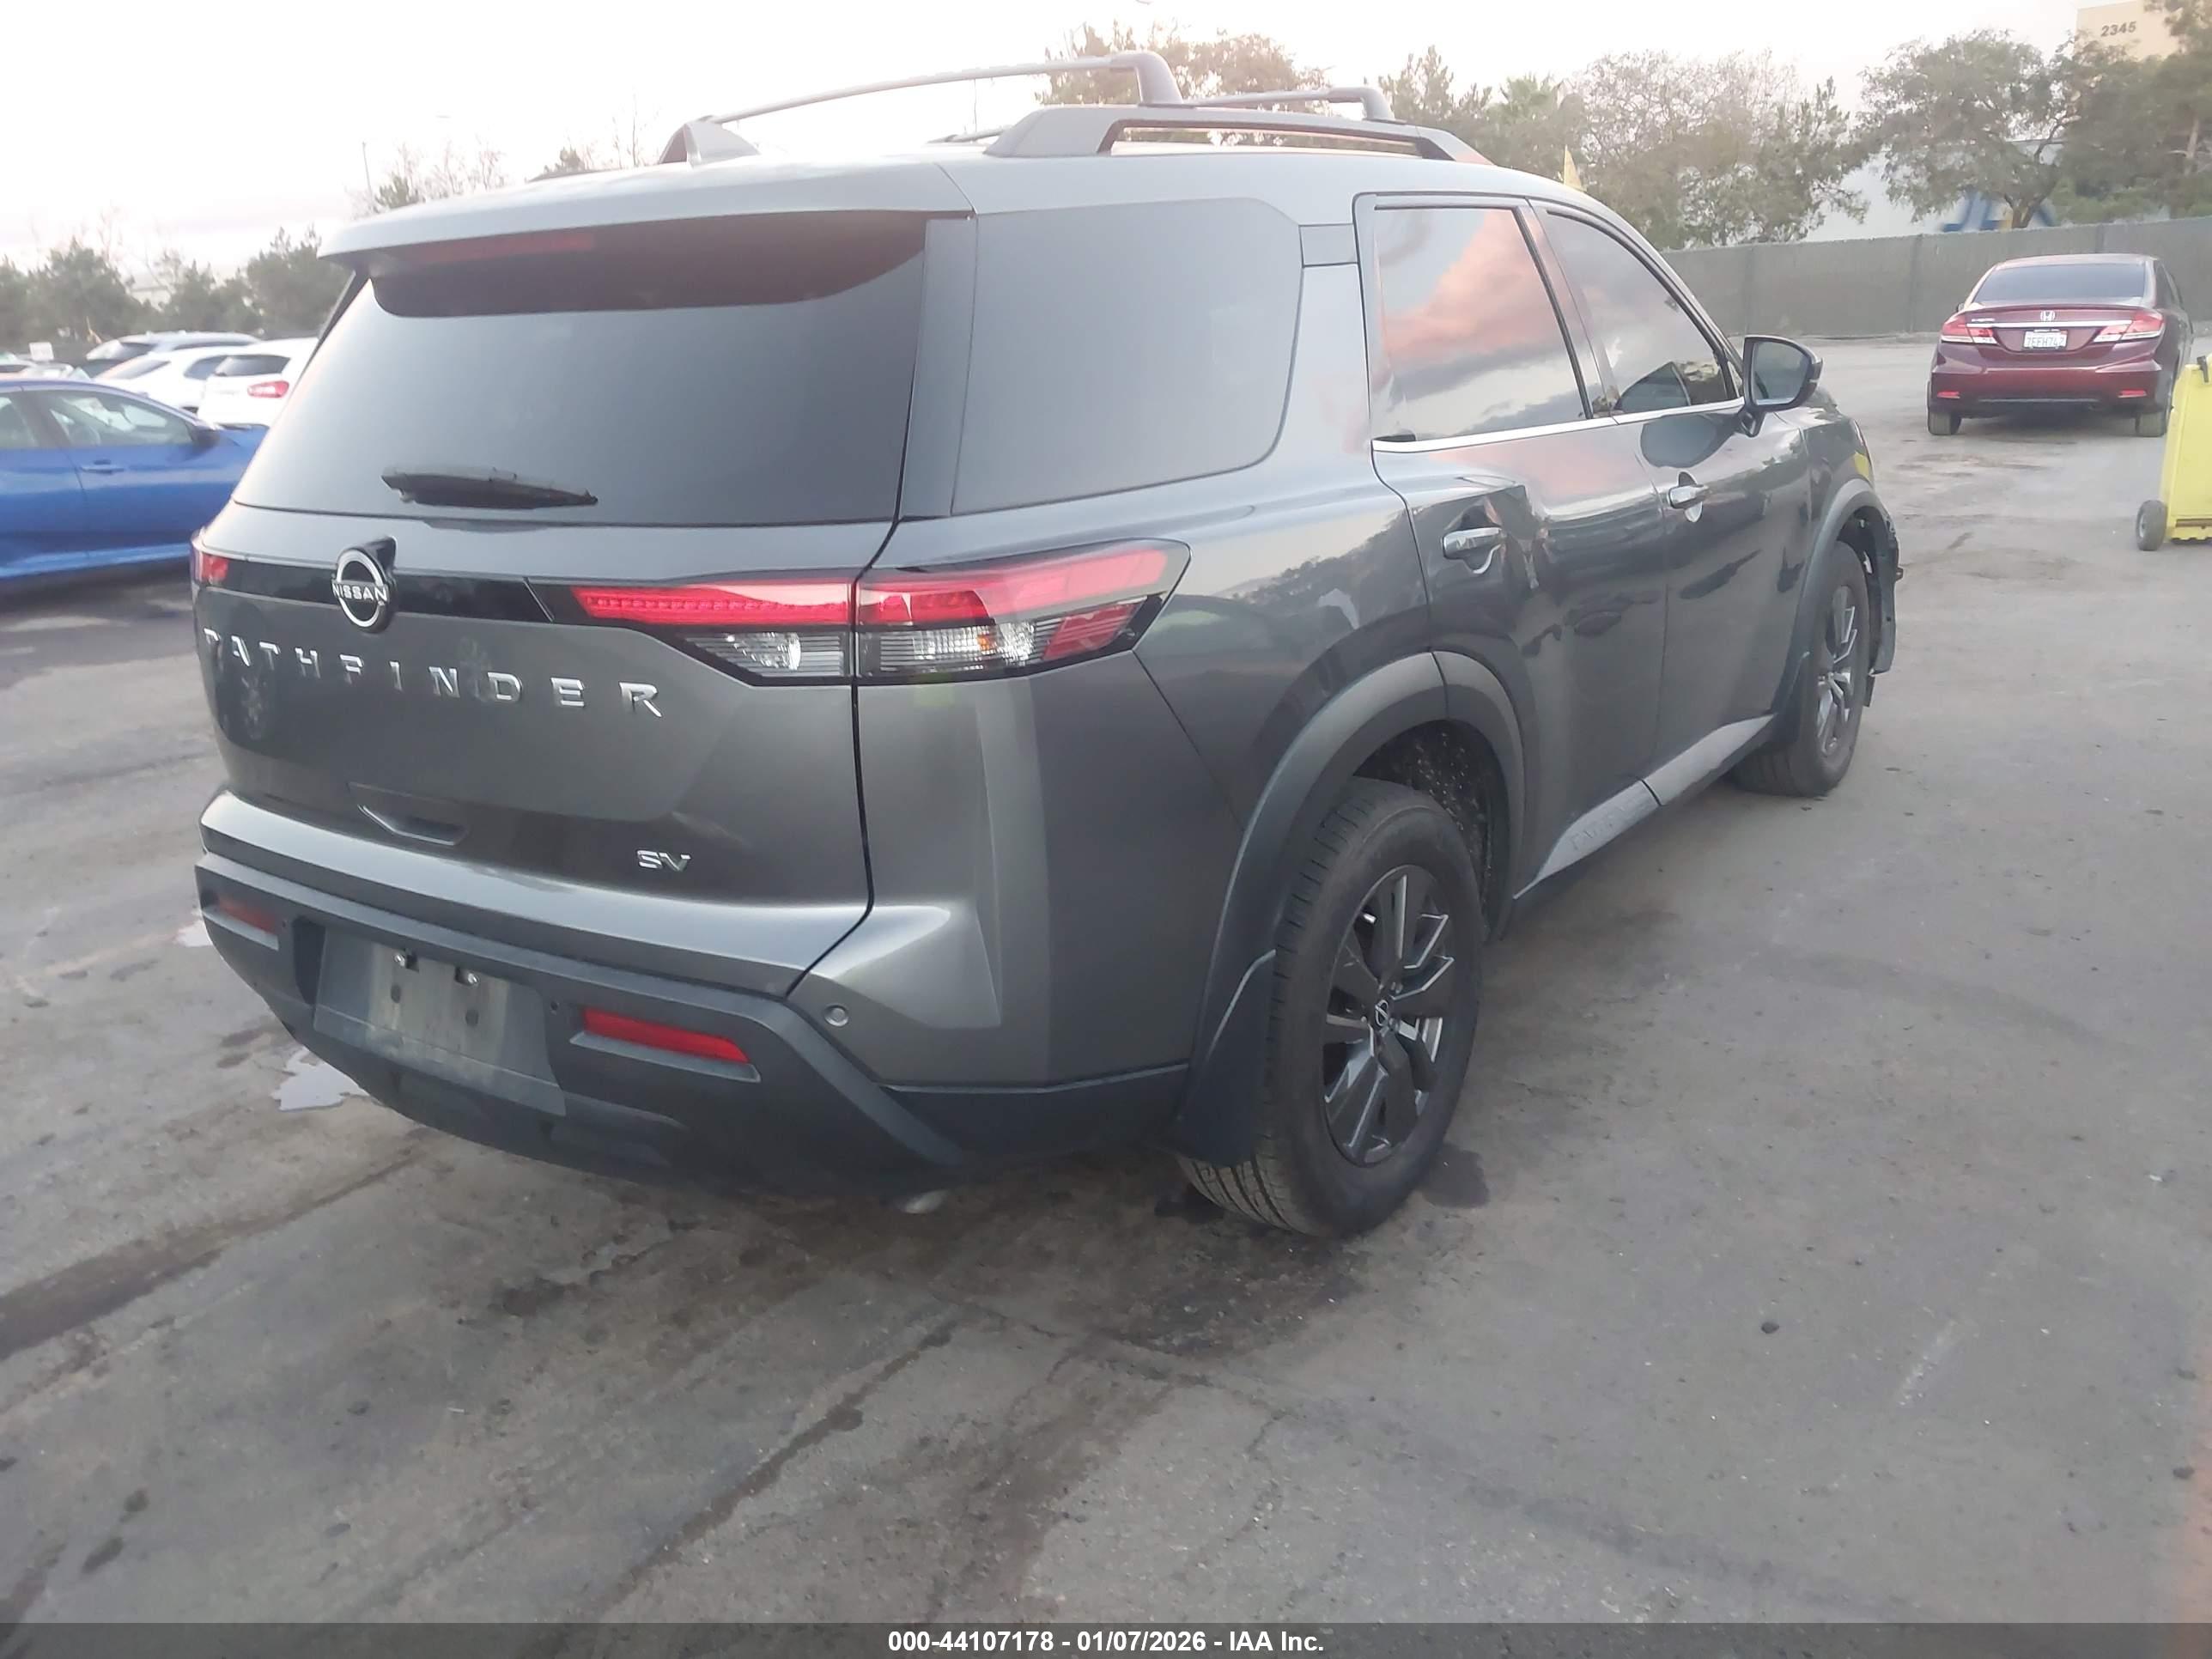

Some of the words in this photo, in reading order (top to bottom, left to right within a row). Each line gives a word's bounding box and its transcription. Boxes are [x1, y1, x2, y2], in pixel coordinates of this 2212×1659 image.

[2100, 21, 2137, 37] 2345
[331, 583, 388, 602] NISSAN
[204, 628, 662, 718] PATHFINDER
[637, 849, 691, 872] SV
